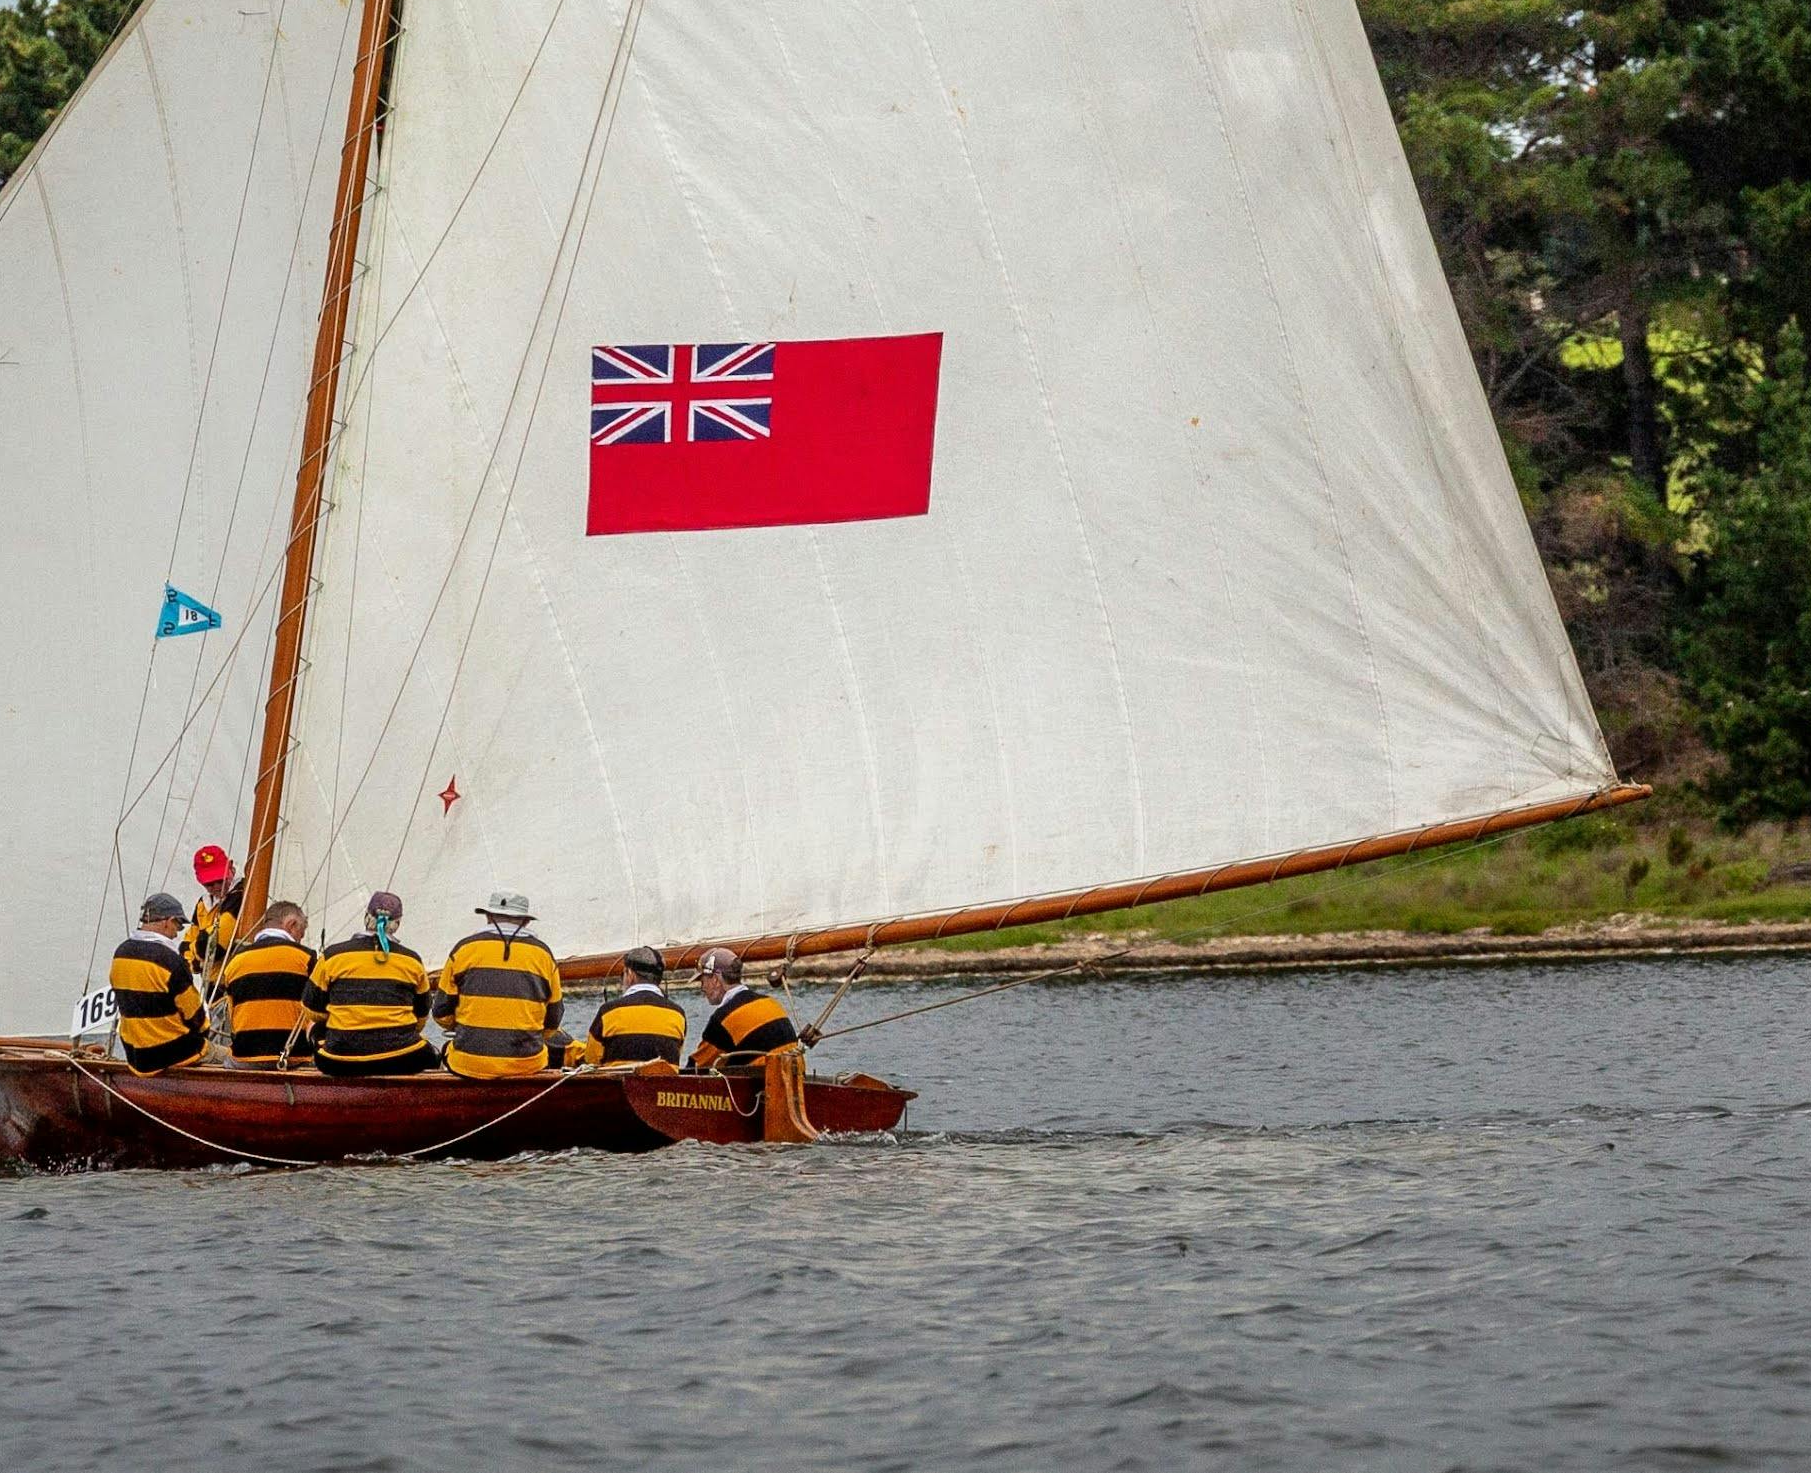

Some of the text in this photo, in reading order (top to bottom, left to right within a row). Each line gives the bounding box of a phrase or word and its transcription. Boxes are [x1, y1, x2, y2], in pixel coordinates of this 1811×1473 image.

[185, 608, 198, 621] 18
[80, 988, 118, 1029] 169
[656, 1091, 733, 1112] BRITANNIA
